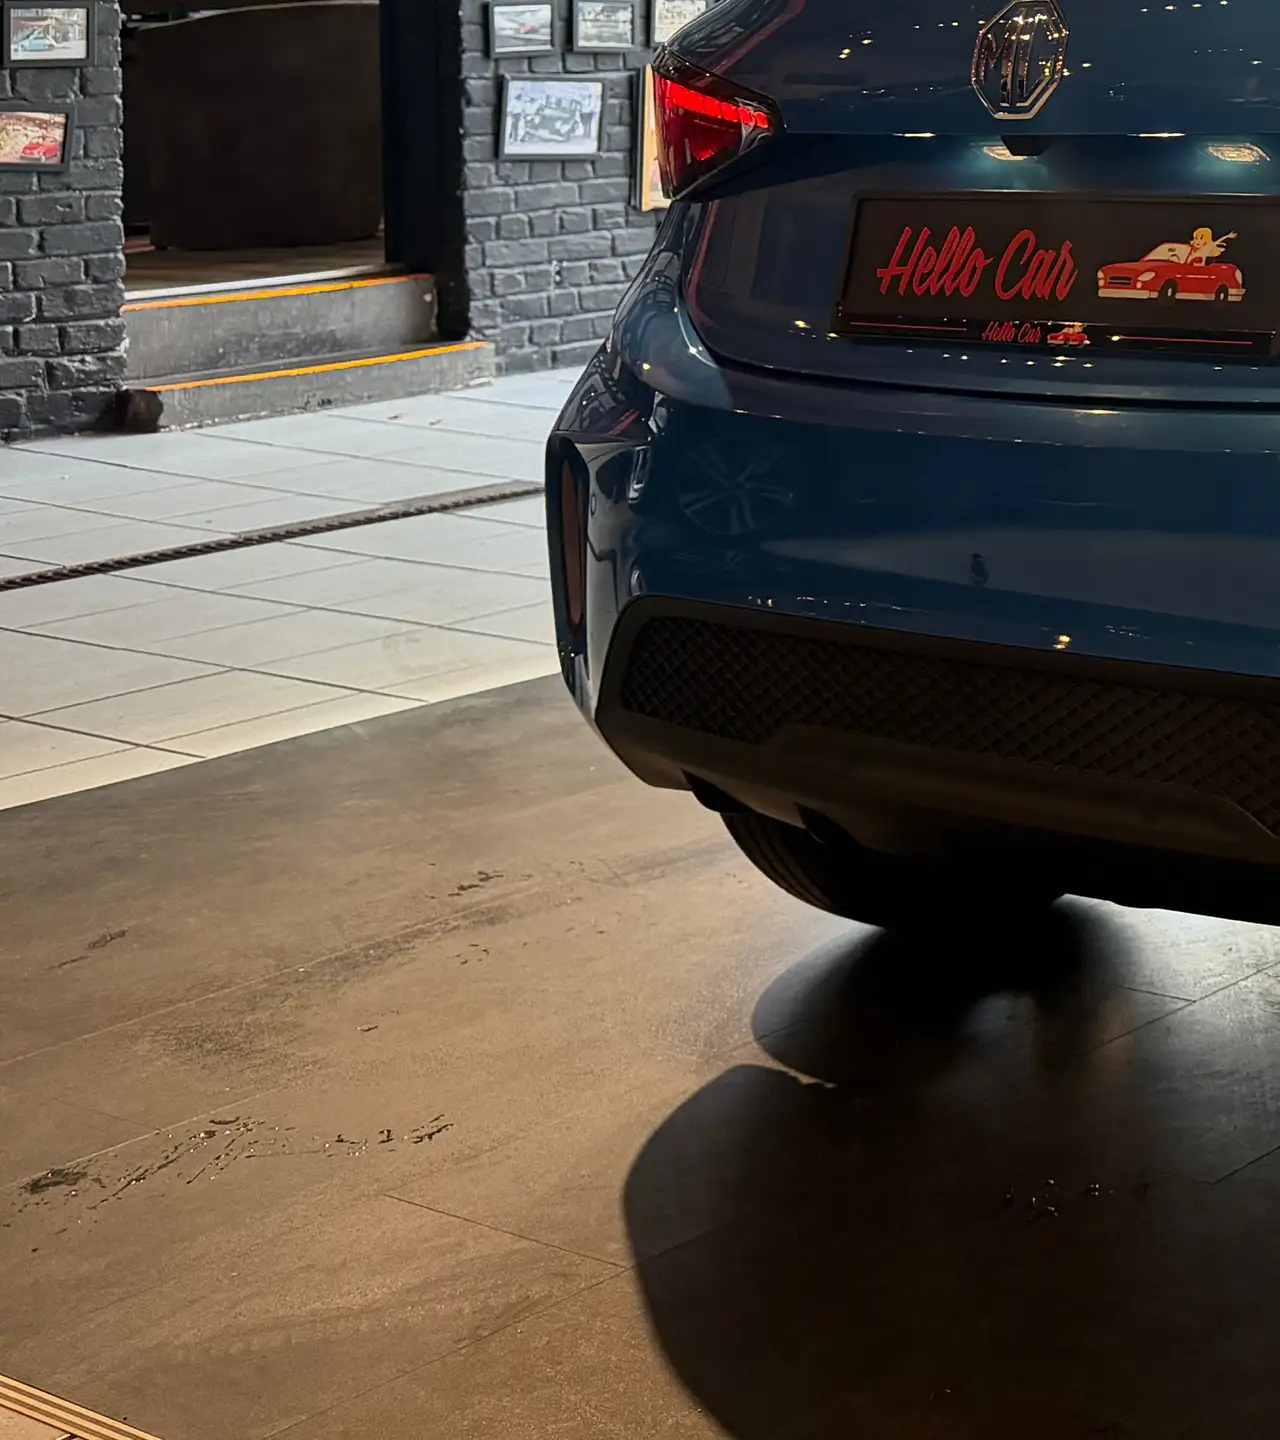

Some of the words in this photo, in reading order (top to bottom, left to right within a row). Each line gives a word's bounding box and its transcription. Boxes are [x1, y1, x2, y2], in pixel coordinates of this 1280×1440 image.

[876, 225, 995, 297] Hello
[994, 228, 1079, 301] Car
[981, 320, 1018, 343] Hello
[1017, 322, 1043, 345] Car
